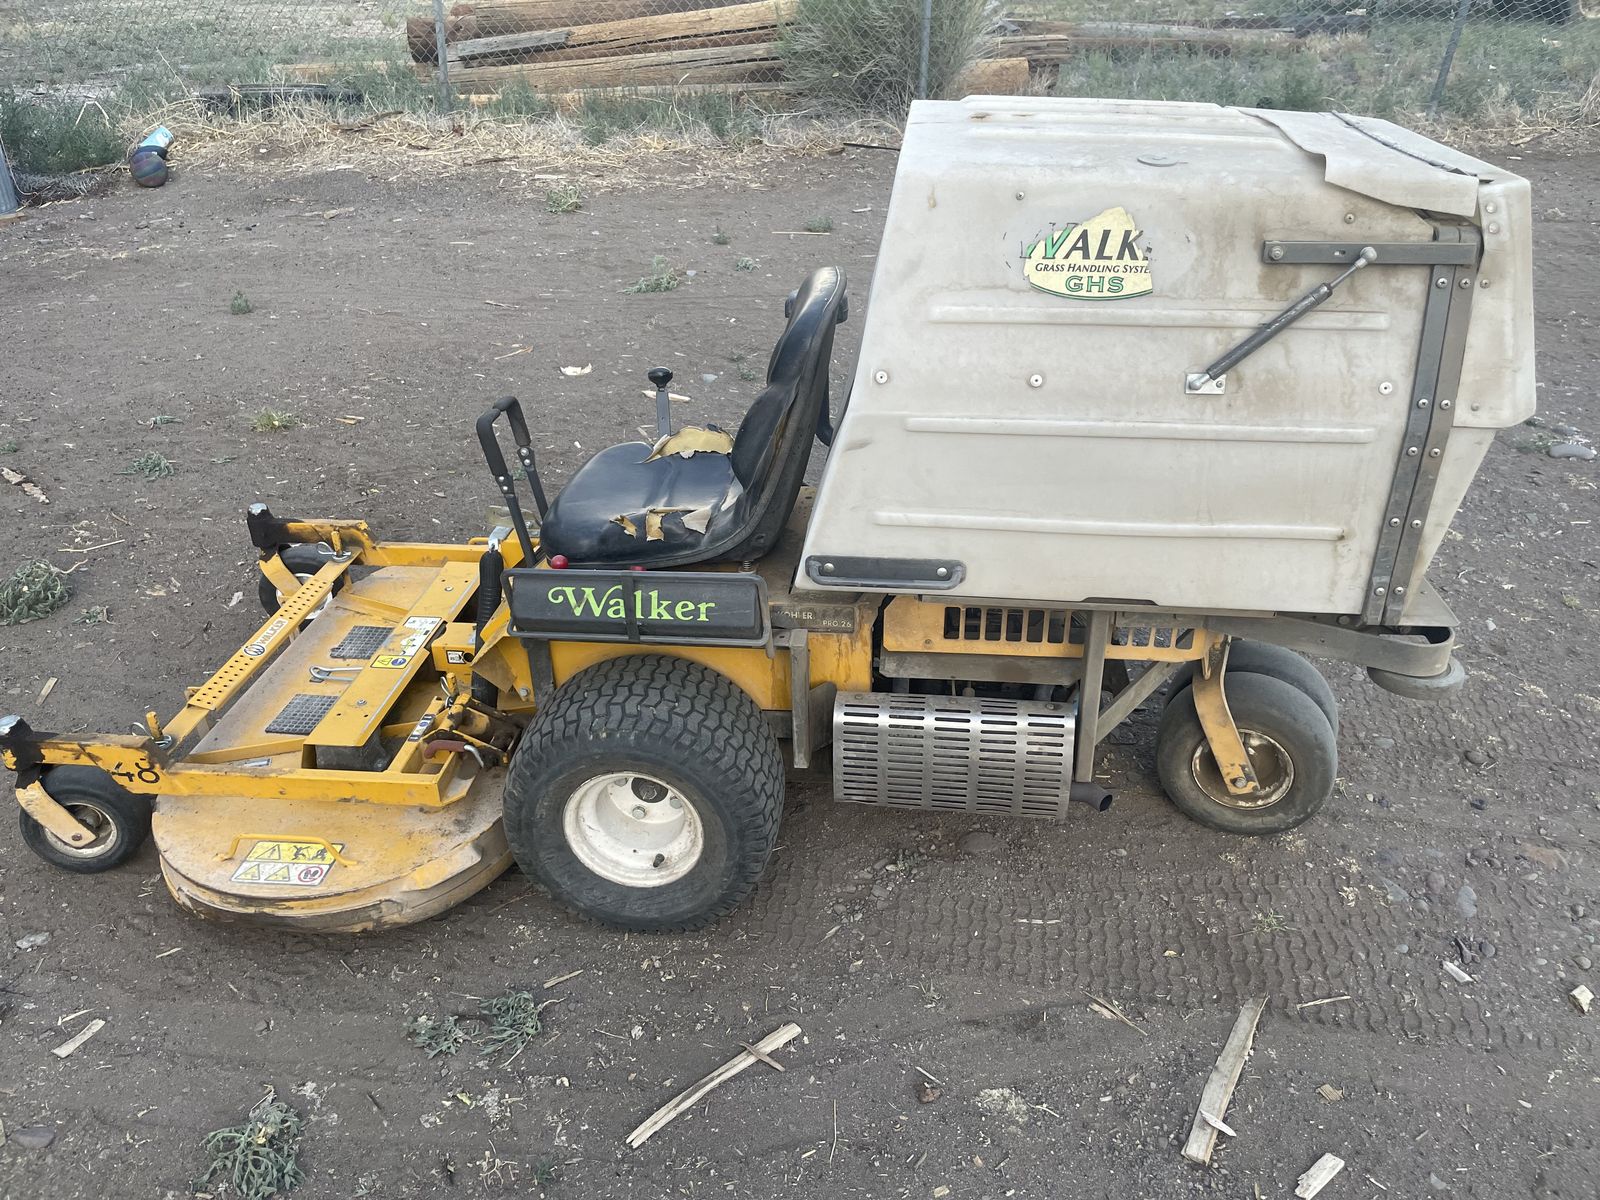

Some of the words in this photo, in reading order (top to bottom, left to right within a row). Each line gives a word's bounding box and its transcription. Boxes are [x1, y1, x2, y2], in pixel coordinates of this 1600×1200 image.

[1020, 222, 1152, 261] WALK
[1035, 262, 1065, 273] GRASS
[1067, 263, 1120, 274] HANDLING
[1065, 275, 1125, 293] GHS
[548, 584, 716, 622] Walker
[841, 620, 852, 628] 26
